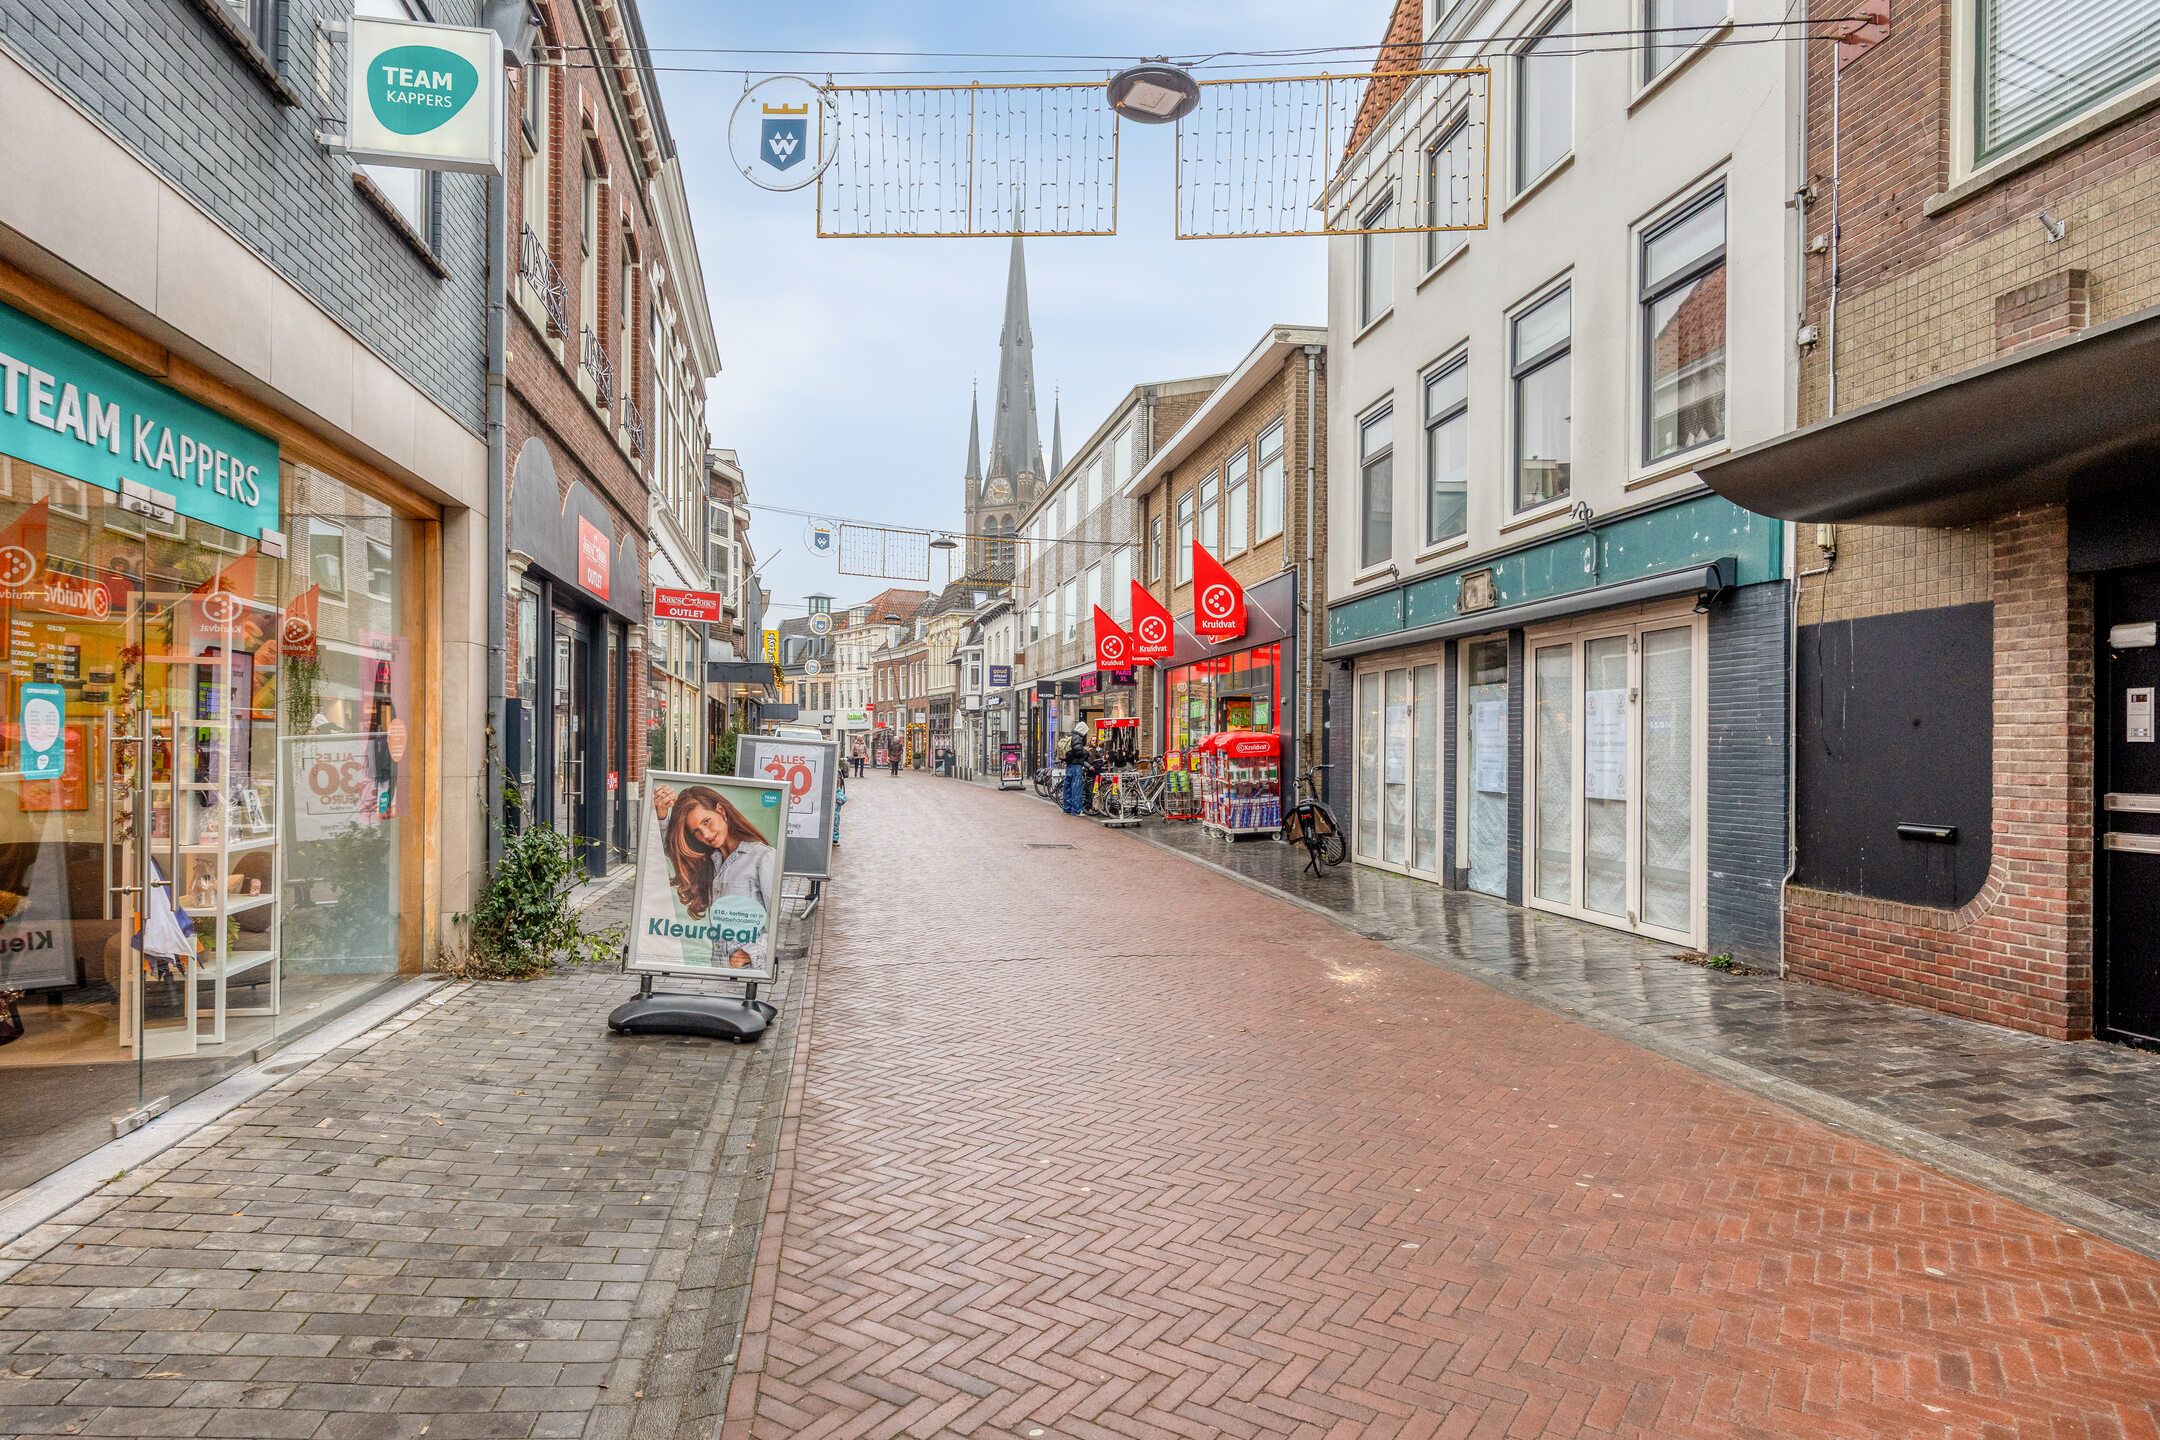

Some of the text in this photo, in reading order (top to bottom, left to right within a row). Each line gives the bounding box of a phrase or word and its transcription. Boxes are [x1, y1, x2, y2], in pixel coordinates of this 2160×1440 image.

[382, 66, 453, 91] TEAM
[386, 90, 452, 108] KAPPERS
[0, 352, 260, 507] TEAM KAPPERS
[588, 567, 602, 590] OUTLET
[670, 608, 704, 618] OUTLET
[1202, 620, 1236, 628] Kruidvat
[772, 754, 806, 764] ALLES
[648, 918, 758, 944] Kleurdeal
